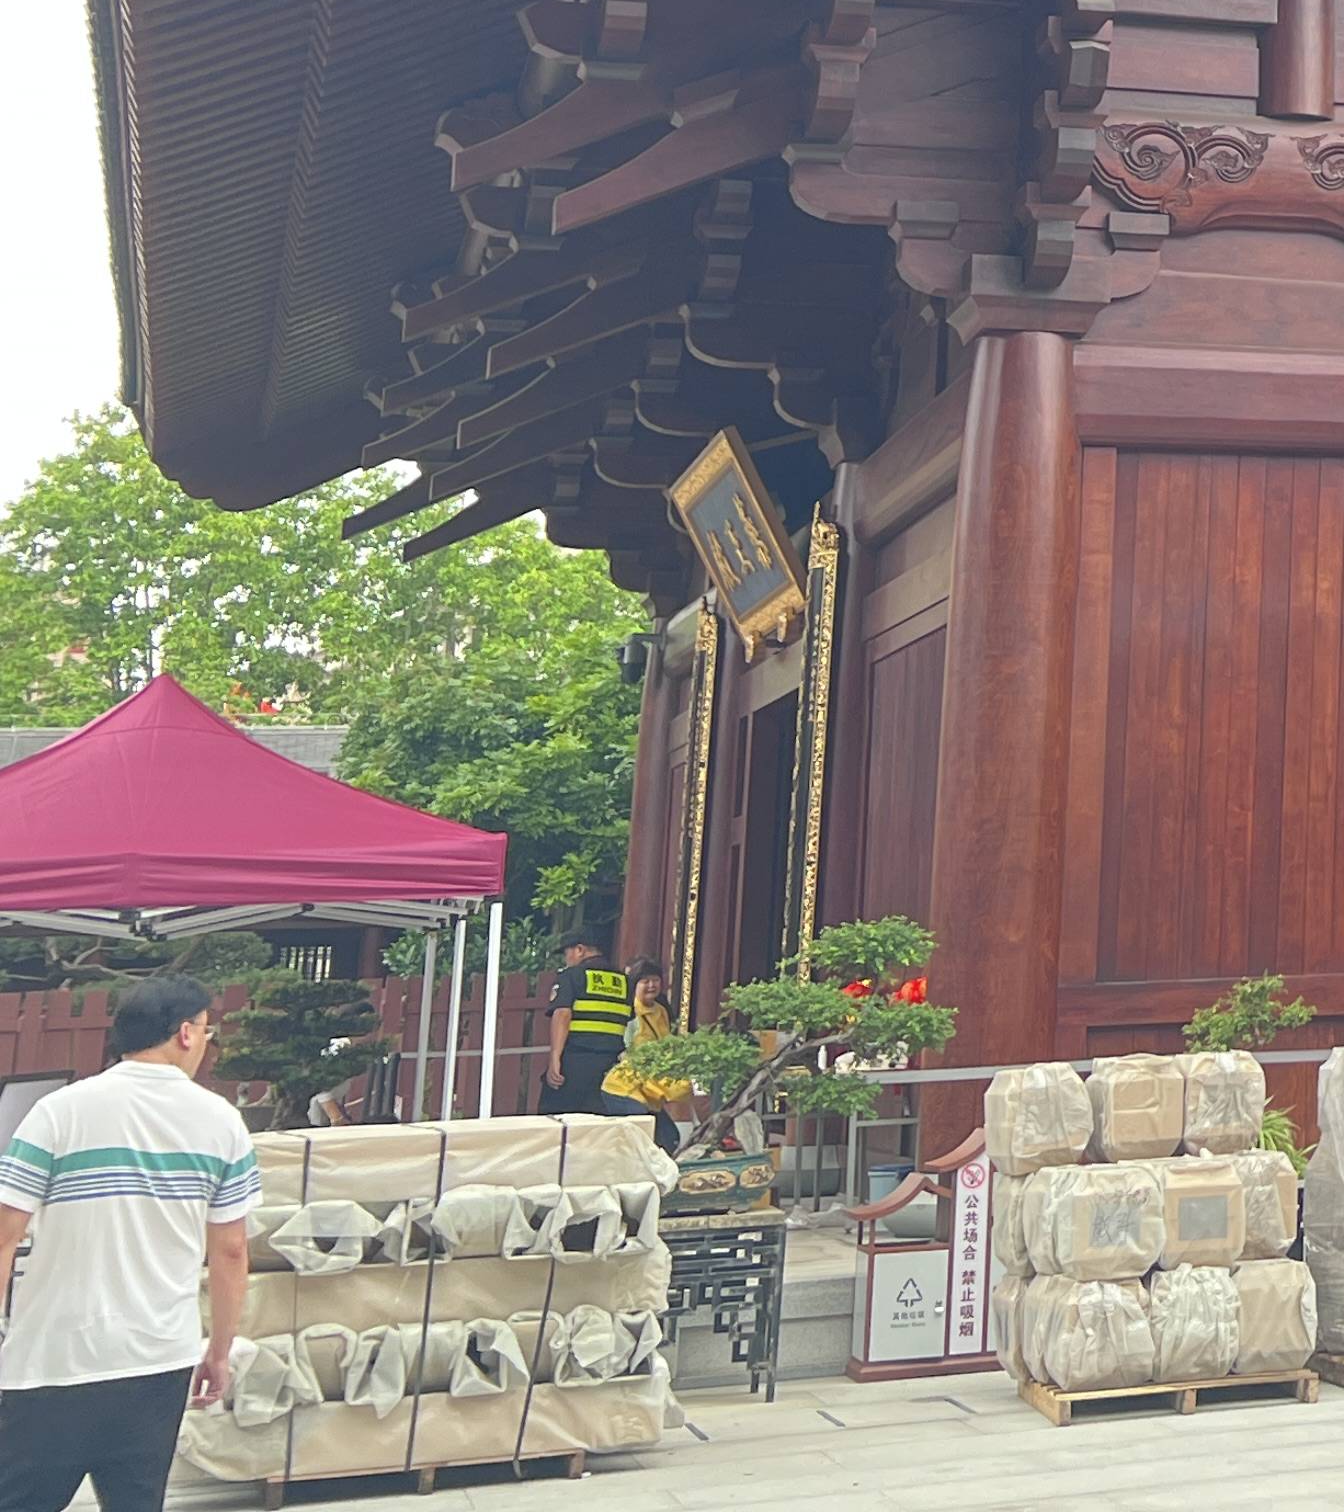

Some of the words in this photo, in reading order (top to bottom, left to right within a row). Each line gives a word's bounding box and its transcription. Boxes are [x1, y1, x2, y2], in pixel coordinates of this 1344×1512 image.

[962, 1194, 979, 1261] 公共场合
[959, 1270, 976, 1337] 禁止吸烟
